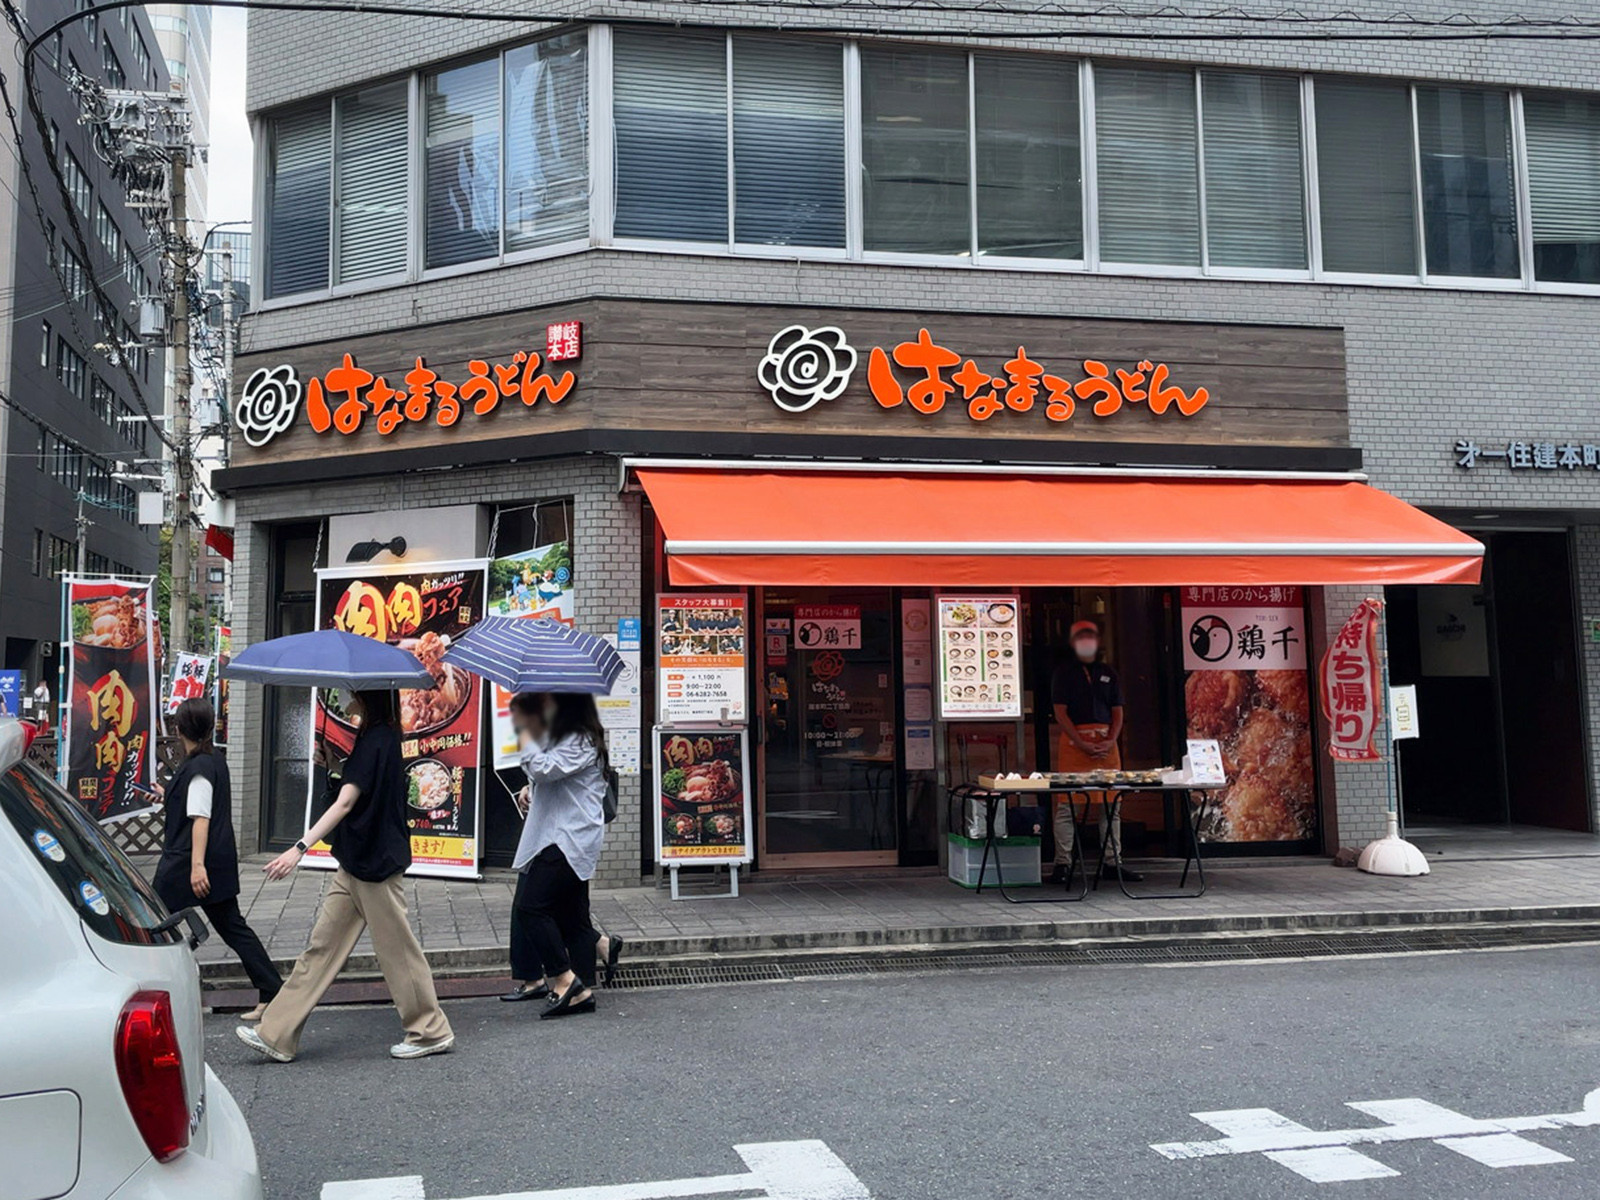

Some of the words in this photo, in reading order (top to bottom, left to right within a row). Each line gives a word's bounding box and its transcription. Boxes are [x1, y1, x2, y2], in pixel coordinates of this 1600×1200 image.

[547, 340, 579, 360] 本店
[868, 328, 1209, 422] はなまるうどん
[306, 352, 575, 435] はなまるうどん
[1187, 586, 1296, 603] 専門店のから揚げ
[824, 626, 858, 646] 鶏千
[1237, 624, 1299, 660] 鶏千
